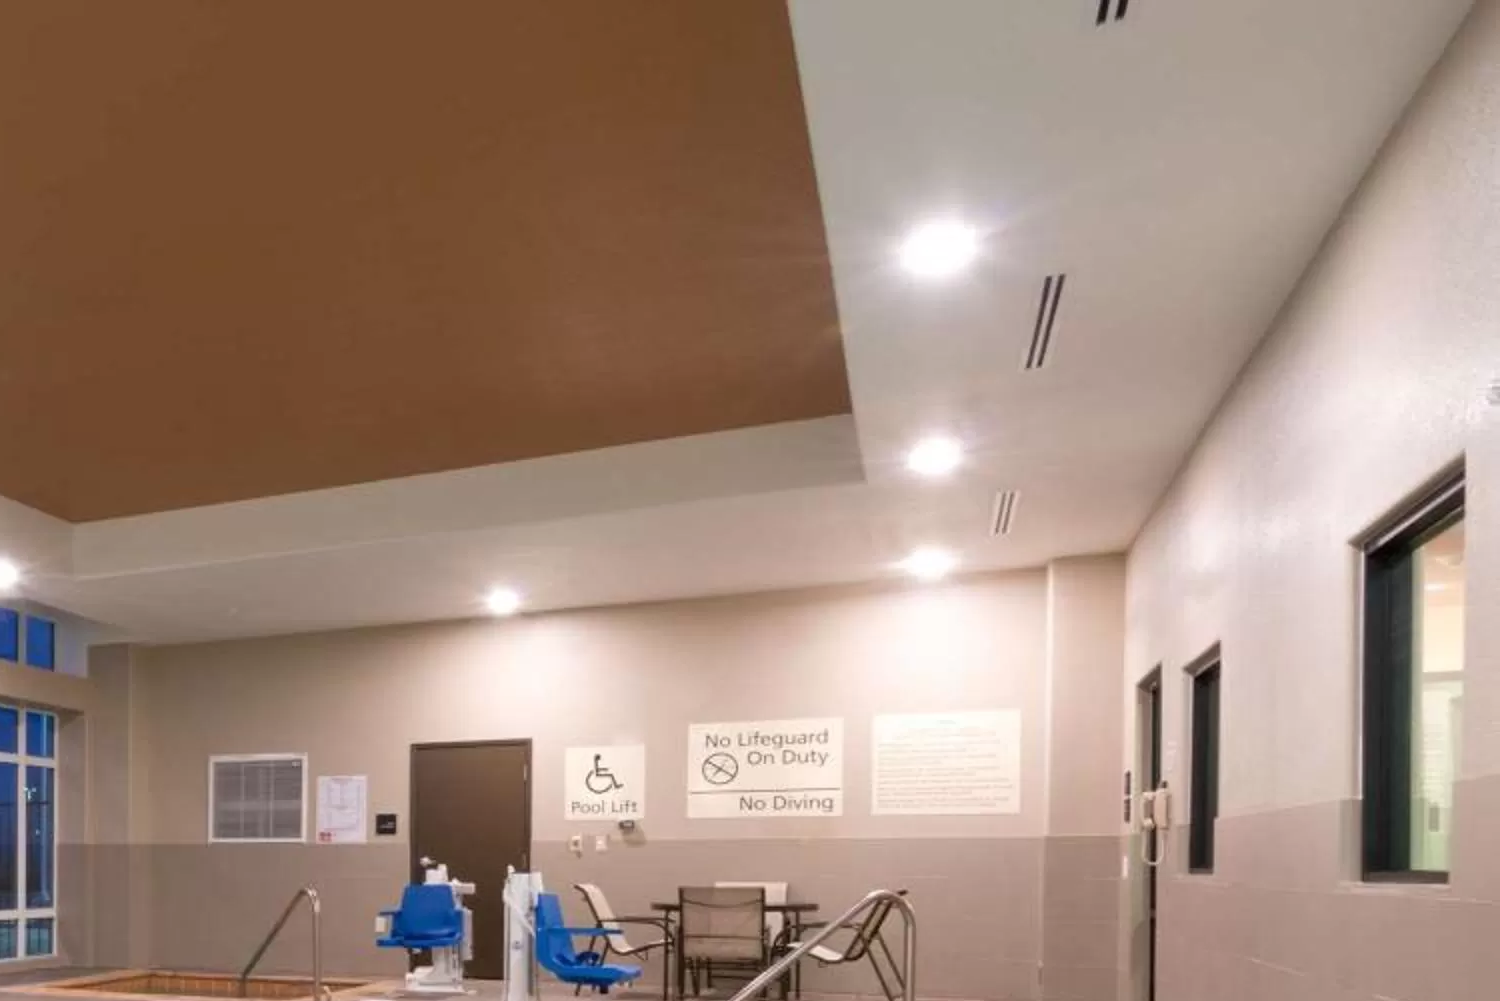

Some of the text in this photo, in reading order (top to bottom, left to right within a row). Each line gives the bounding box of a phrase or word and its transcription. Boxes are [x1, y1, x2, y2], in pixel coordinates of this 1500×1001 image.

[705, 728, 829, 749] No Lifeguard
[747, 749, 829, 766] On Duty
[571, 799, 638, 815] Pool Lift
[739, 794, 834, 812] No Diving
